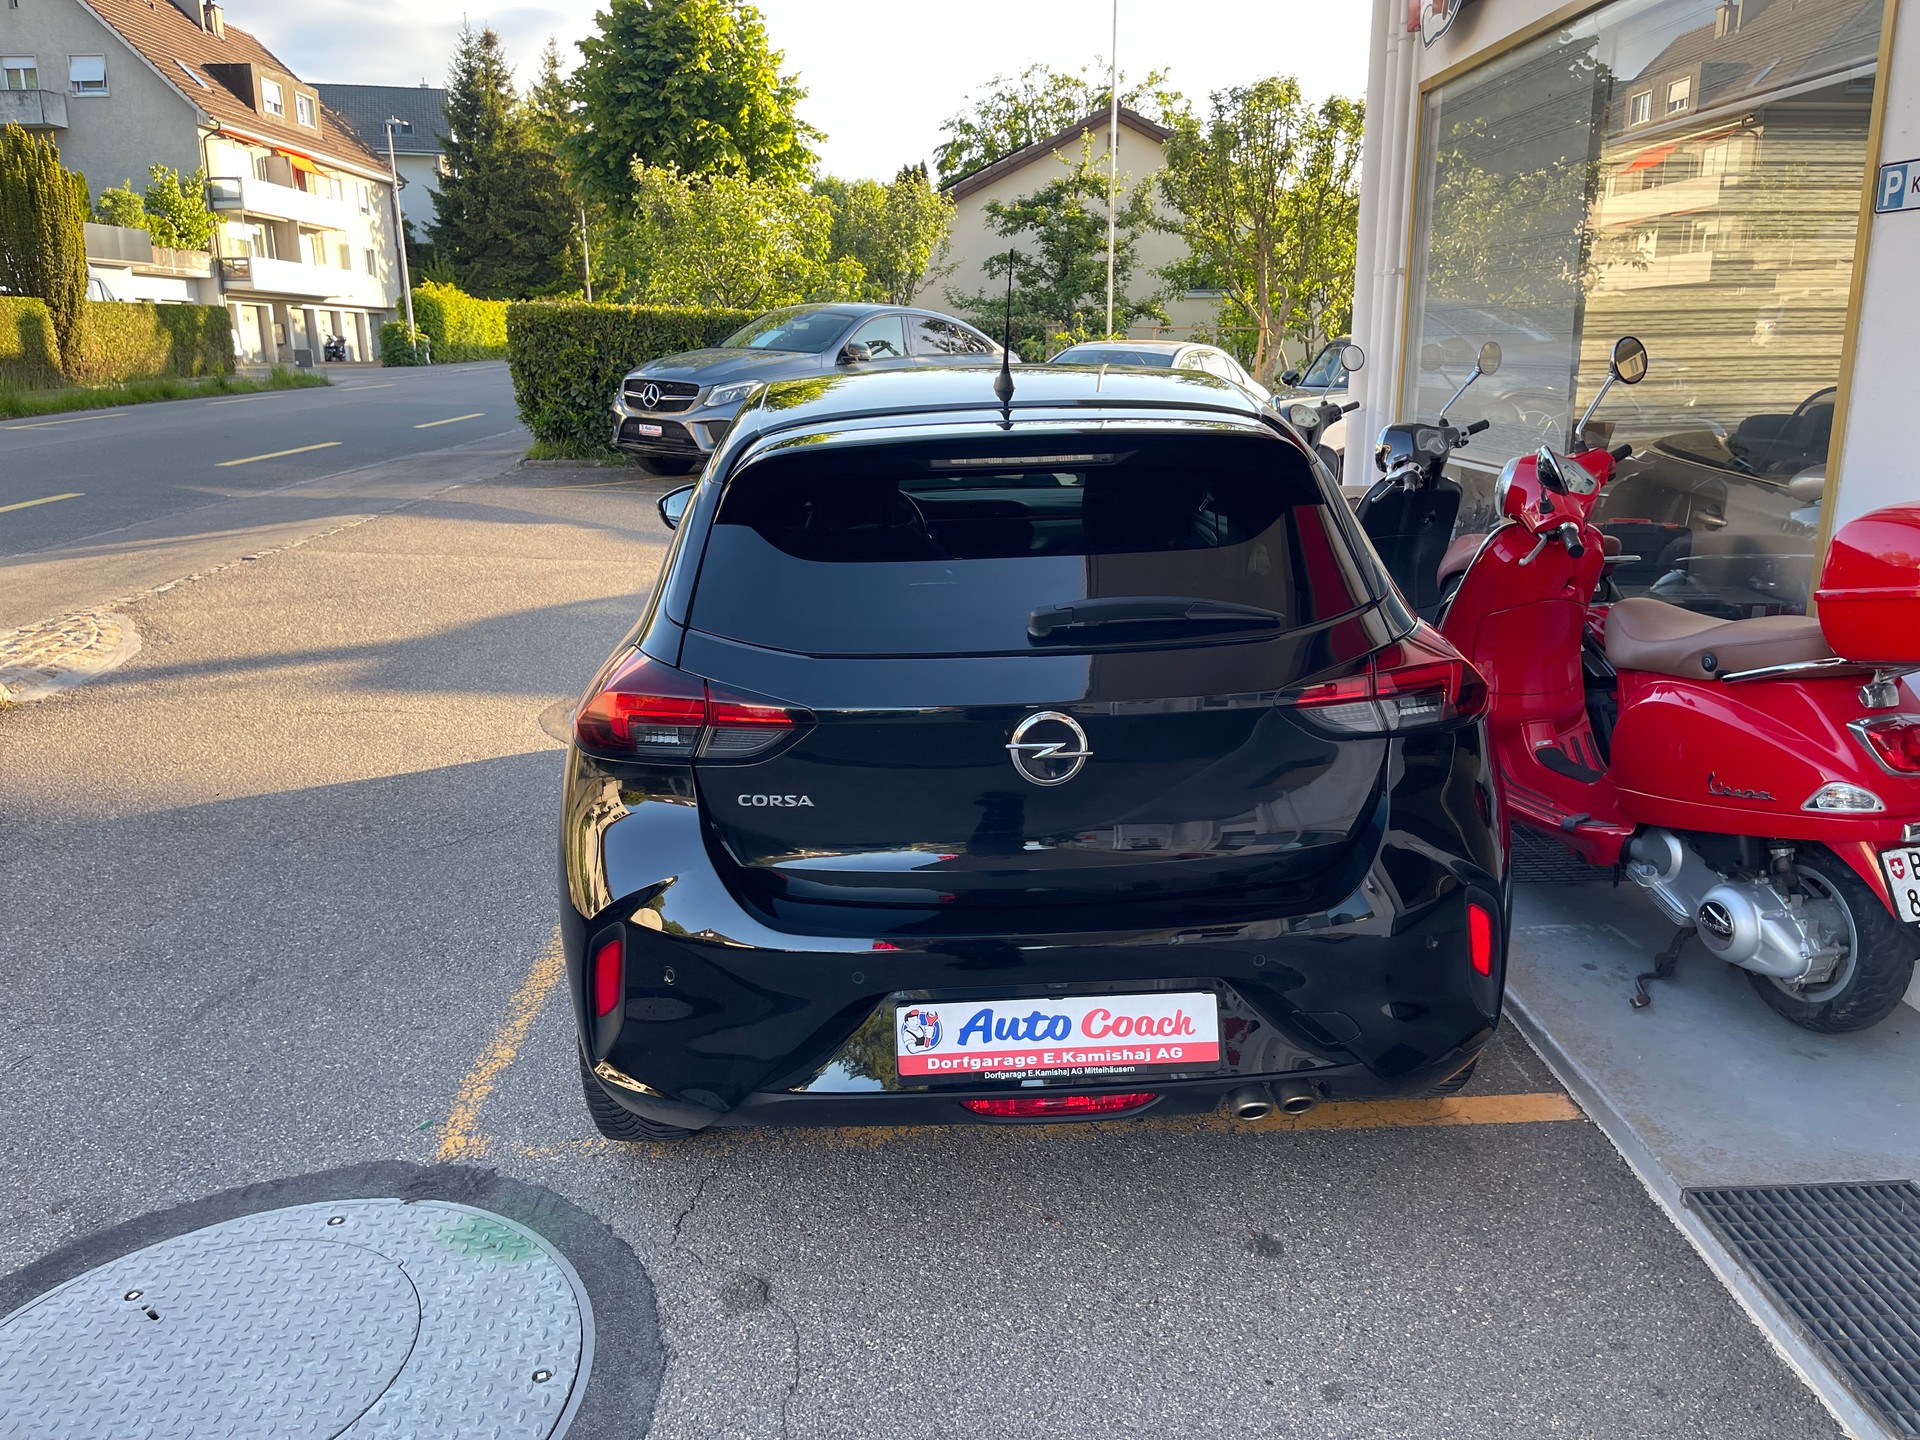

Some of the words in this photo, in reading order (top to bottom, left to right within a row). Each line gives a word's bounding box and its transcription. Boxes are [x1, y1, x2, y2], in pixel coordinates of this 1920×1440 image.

[1883, 170, 1903, 207] P
[737, 794, 815, 807] CORSA
[957, 1008, 1072, 1046] Auto
[1081, 1008, 1197, 1039] Coach
[927, 1055, 1038, 1070] Dorfgarage
[1043, 1047, 1151, 1064] E.Kamishaj
[1156, 1047, 1183, 1060] AG
[984, 1070, 1026, 1079] Dorfgarage
[1028, 1068, 1070, 1078] E.Kamishaj
[1071, 1068, 1083, 1076] AG
[1084, 1066, 1135, 1075] Mittelhäusern
